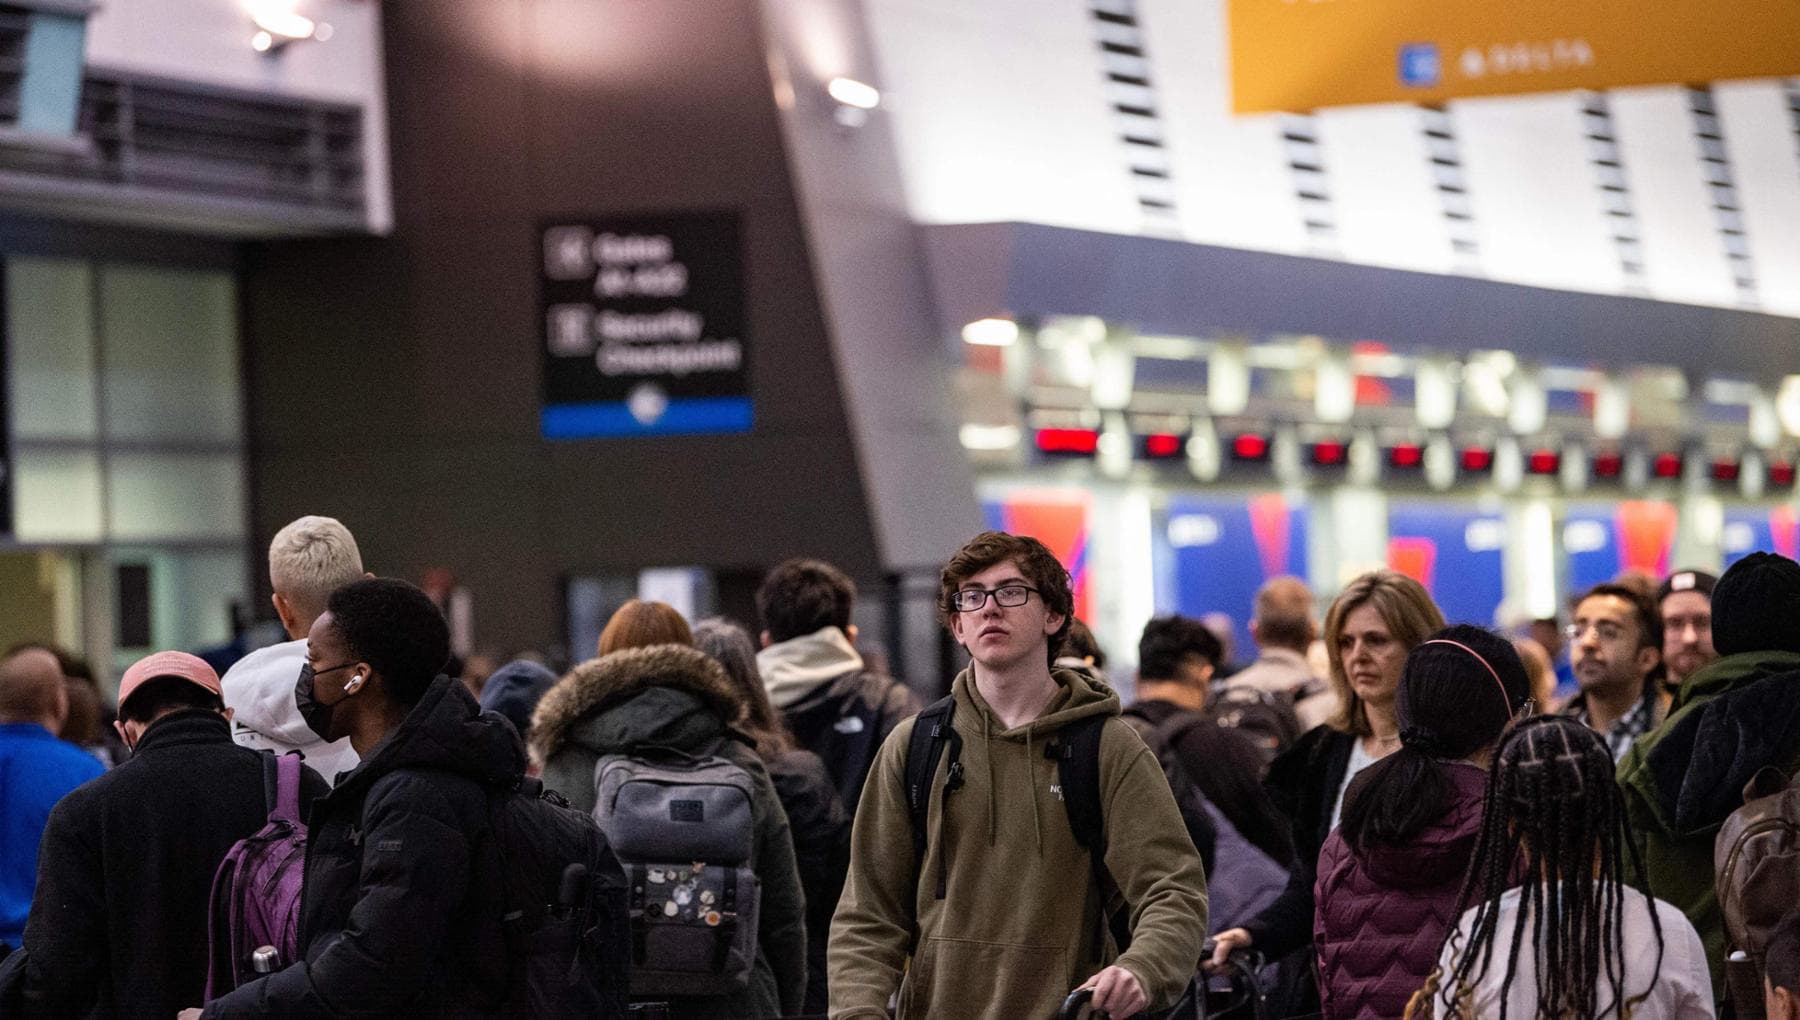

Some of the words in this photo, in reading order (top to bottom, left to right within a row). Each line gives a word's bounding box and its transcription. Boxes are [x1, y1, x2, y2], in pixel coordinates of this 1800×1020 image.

[1489, 39, 1594, 75] DELTA
[598, 311, 703, 342] Security
[598, 340, 742, 373] Checkpoint
